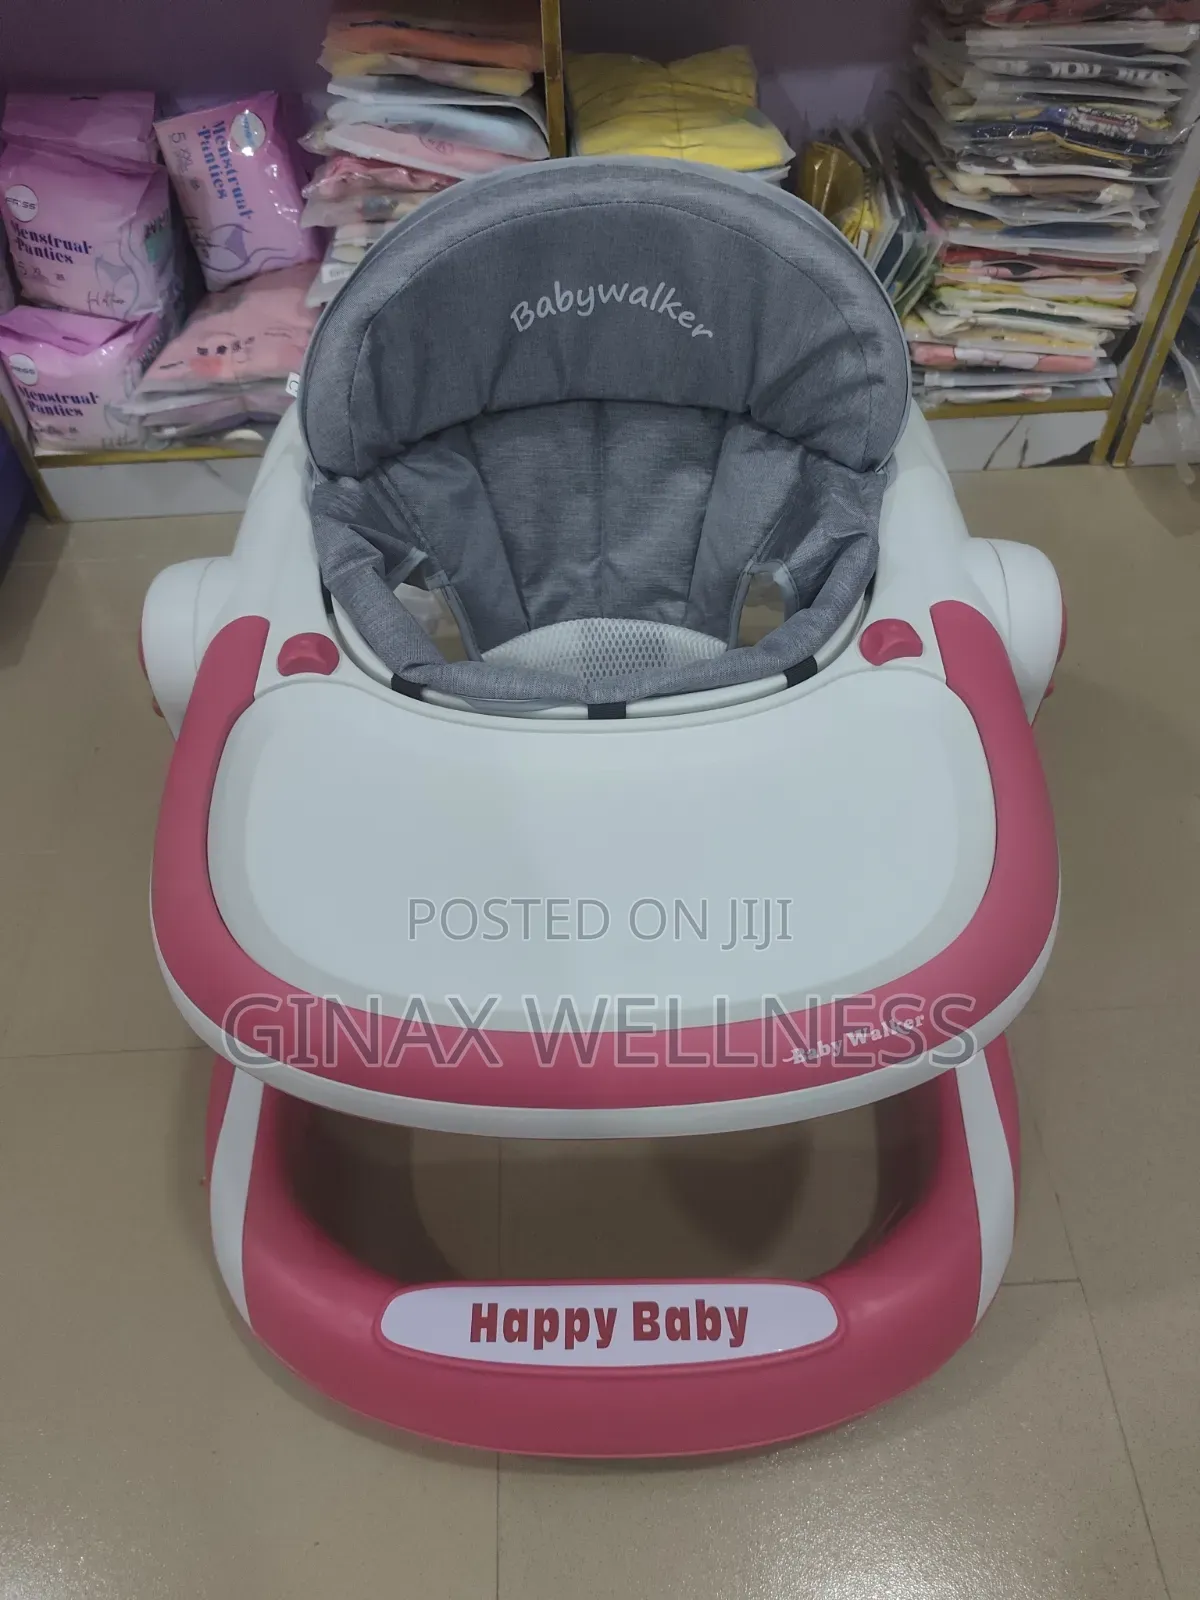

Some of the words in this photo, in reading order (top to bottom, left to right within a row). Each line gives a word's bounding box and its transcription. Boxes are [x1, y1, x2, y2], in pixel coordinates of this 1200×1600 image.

[11, 220, 90, 255] Menstrual
[16, 237, 74, 265] Panties
[510, 281, 713, 338] Babywalker
[18, 386, 98, 406] Menstrual
[27, 401, 84, 417] Panties
[782, 1040, 842, 1064] Baby
[846, 1014, 925, 1047] Walker
[470, 1303, 617, 1350] Happy
[633, 1299, 748, 1348] Baby
